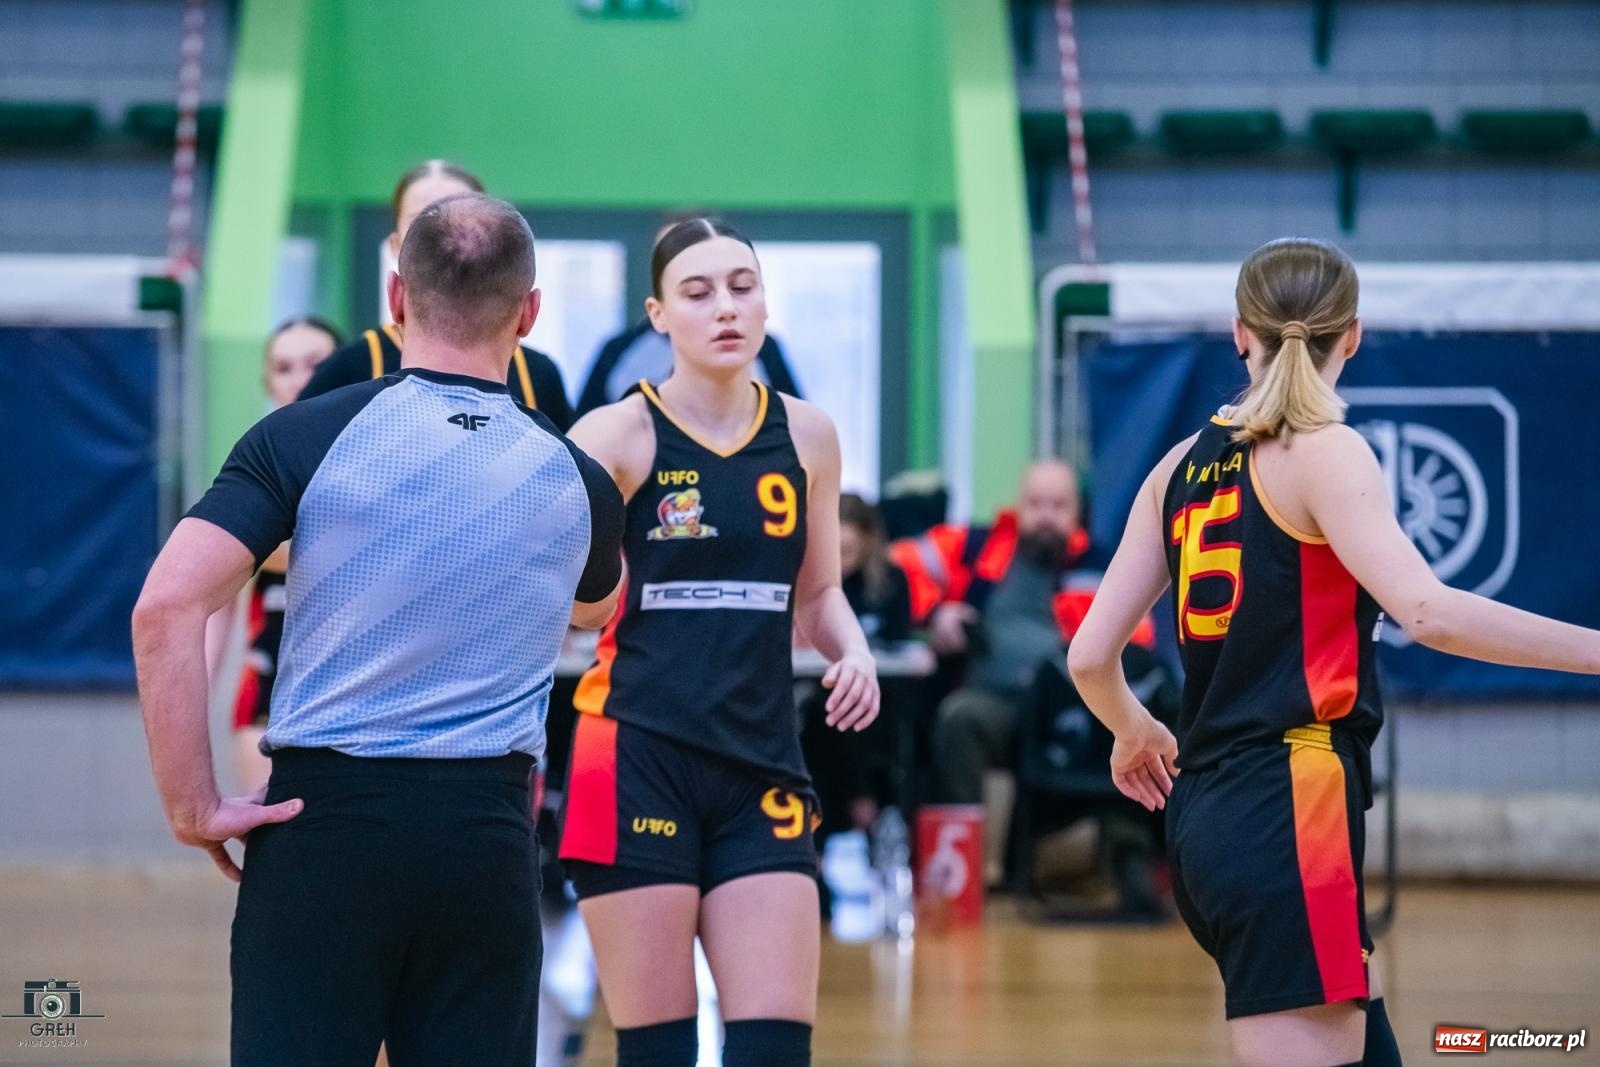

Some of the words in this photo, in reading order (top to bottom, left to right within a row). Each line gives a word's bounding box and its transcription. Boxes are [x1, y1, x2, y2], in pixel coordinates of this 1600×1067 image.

[757, 472, 798, 538] 9
[1171, 485, 1244, 644] 15
[760, 787, 804, 839] 9
